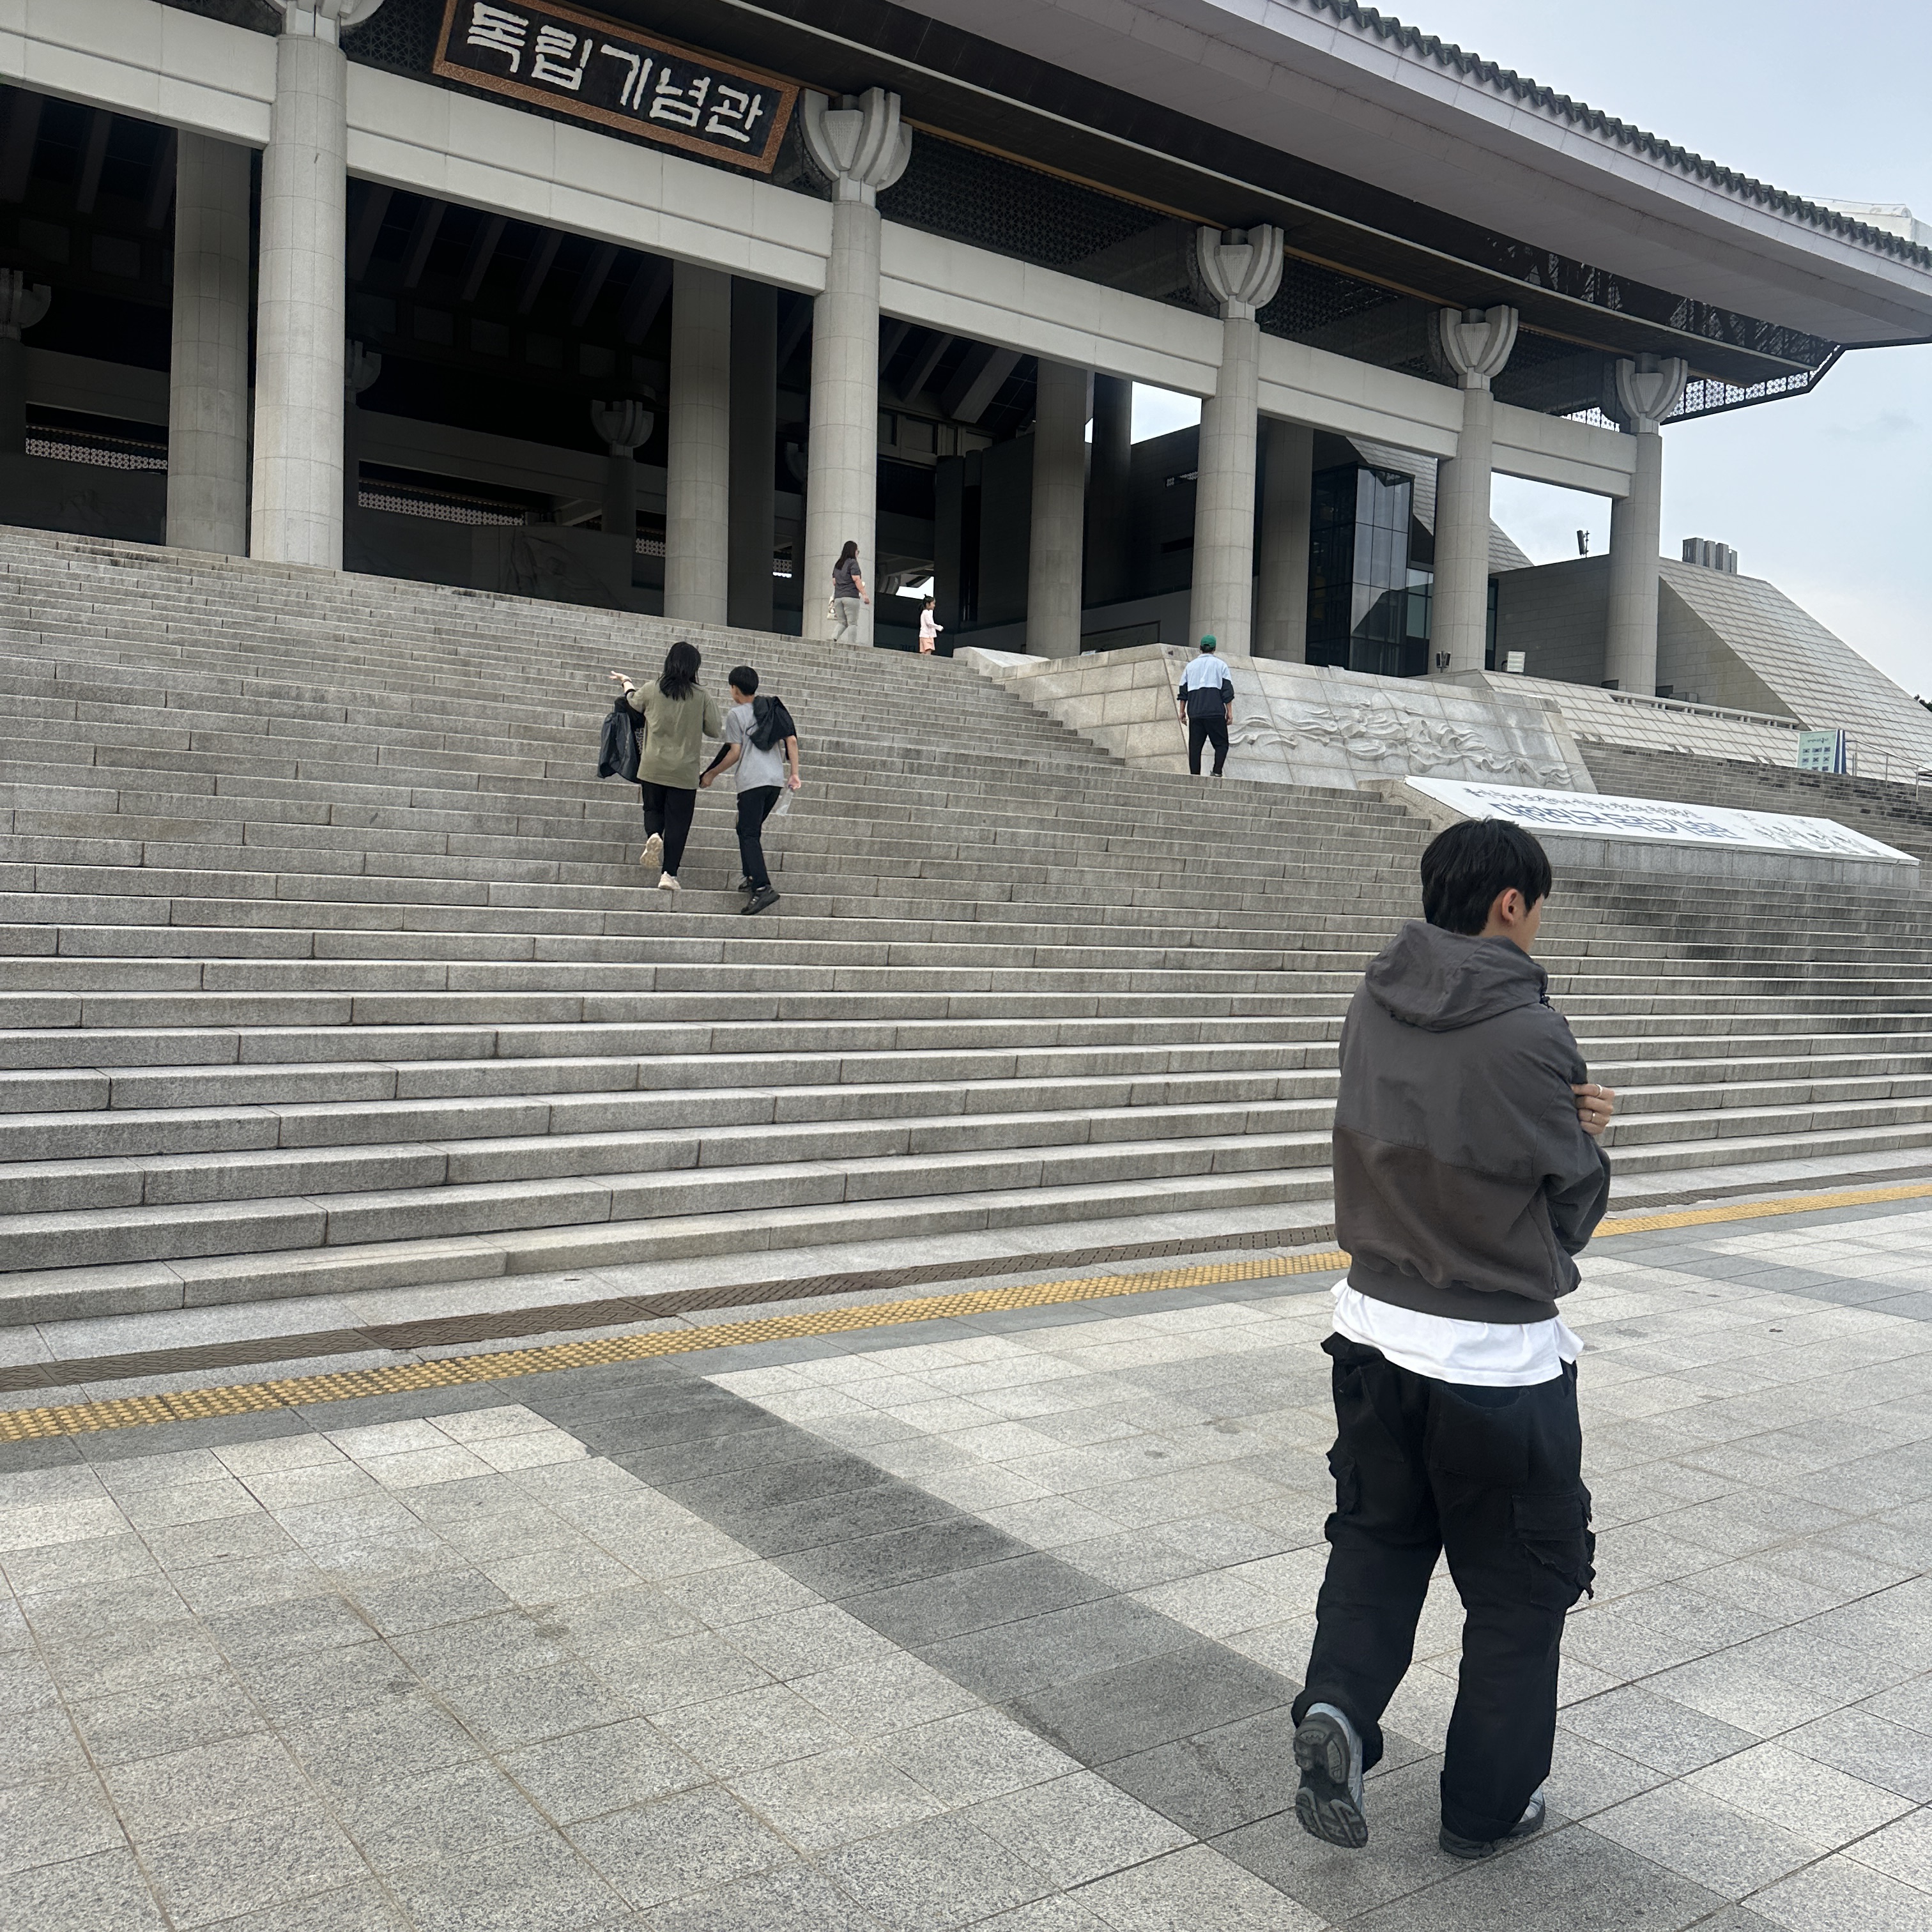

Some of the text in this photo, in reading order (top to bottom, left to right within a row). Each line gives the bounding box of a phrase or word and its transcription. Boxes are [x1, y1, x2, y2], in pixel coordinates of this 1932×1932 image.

[467, 2, 763, 142] 독립기념관
[1487, 802, 1748, 839] 대한민국 독립기념관
